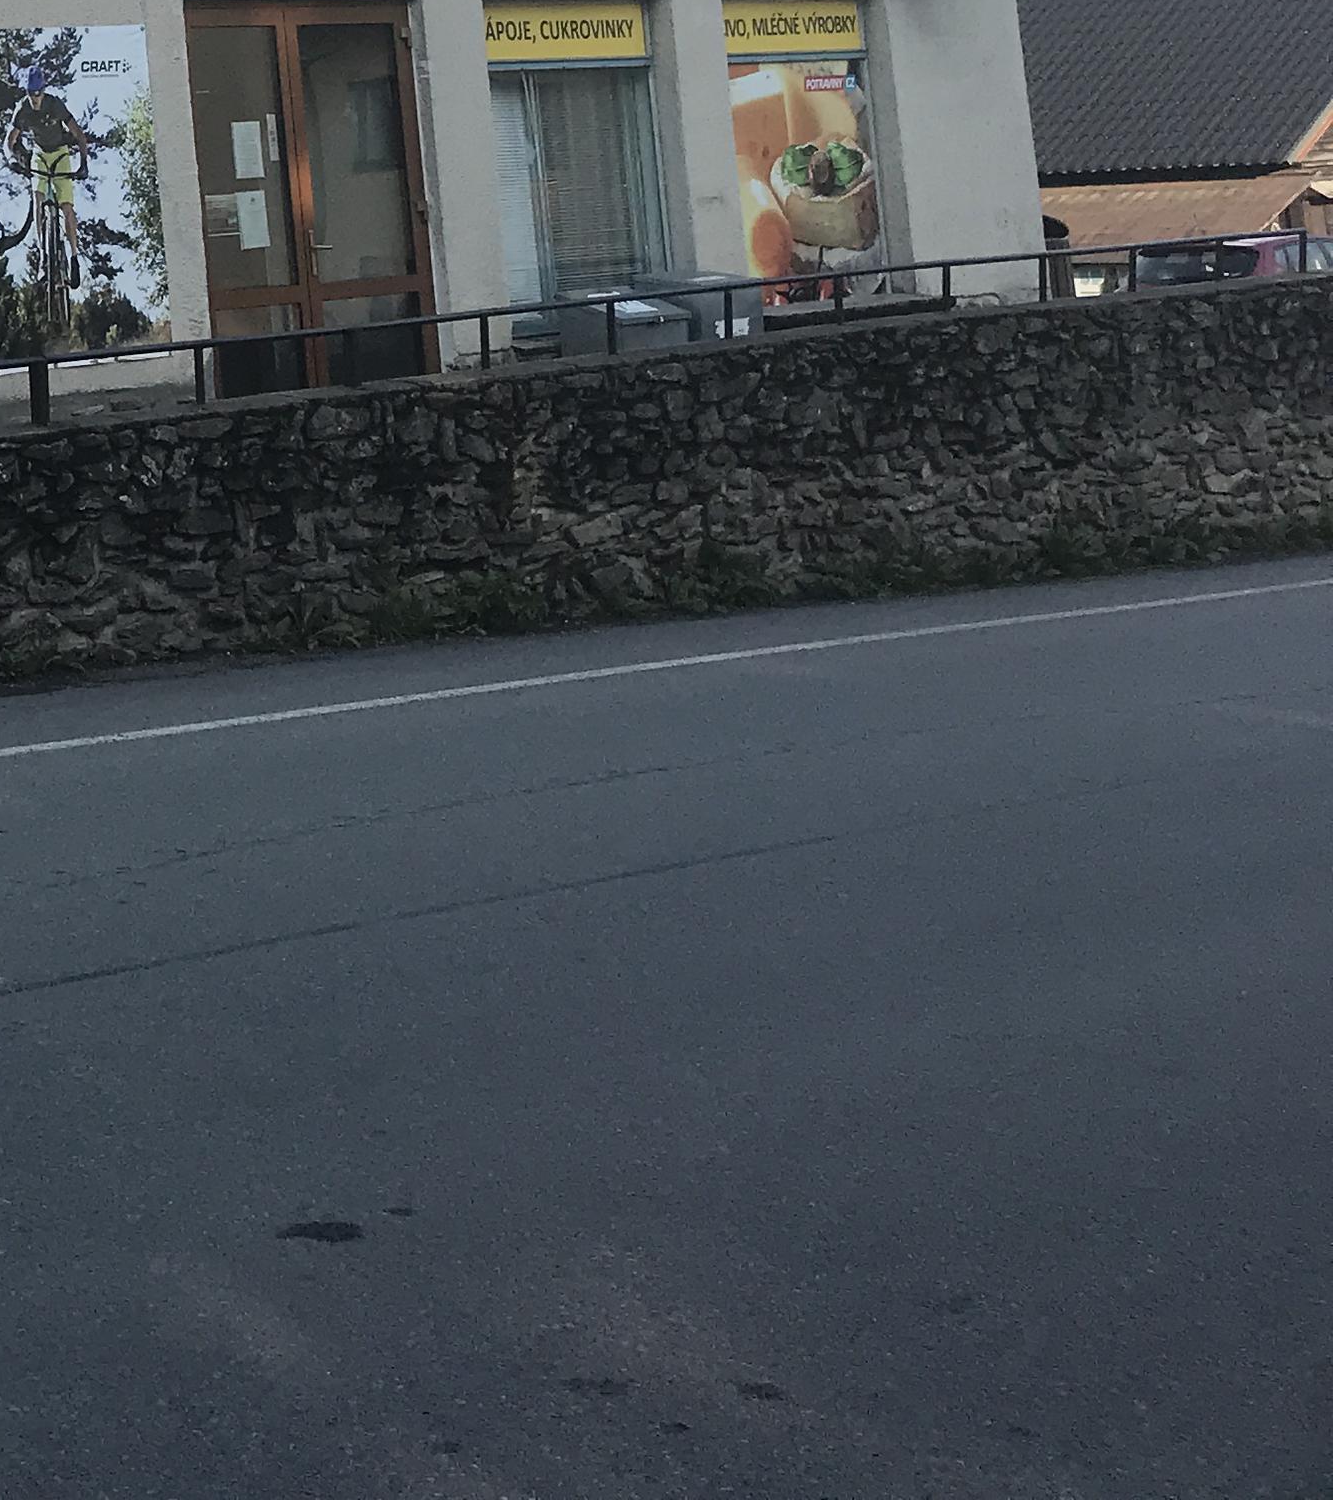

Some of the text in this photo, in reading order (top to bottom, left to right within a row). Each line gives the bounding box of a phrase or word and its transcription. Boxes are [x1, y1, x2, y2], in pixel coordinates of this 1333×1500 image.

[485, 16, 634, 44] ÁPOJE, CUKROVINKY
[724, 12, 857, 40] IVO, MLÉČNÉ VÝROBKY
[81, 60, 121, 73] CRAFT
